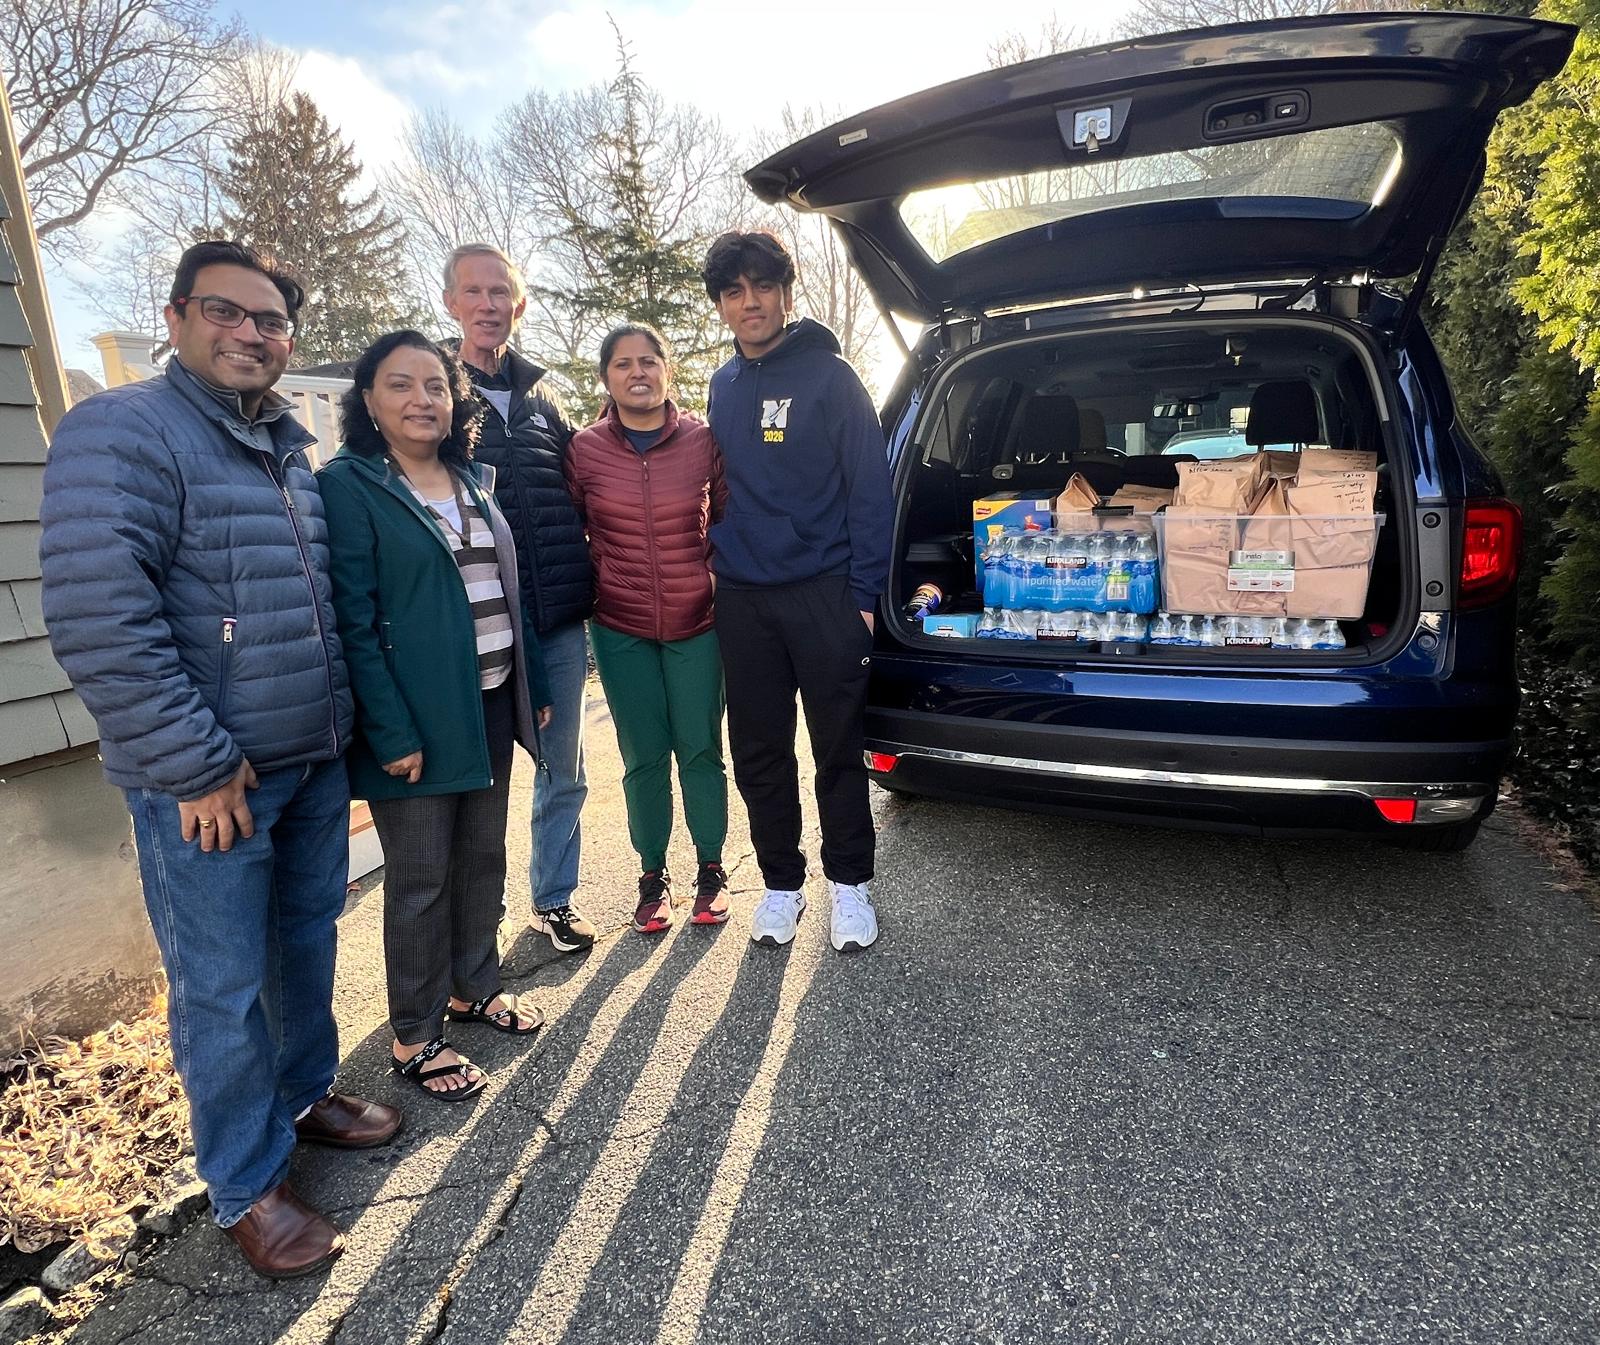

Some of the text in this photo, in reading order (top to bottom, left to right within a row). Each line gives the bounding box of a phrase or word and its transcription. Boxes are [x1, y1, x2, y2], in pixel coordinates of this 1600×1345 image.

[763, 430, 784, 443] 2026
[1046, 557, 1086, 565] KIRKLAND
[1030, 575, 1070, 587] purified
[1037, 630, 1077, 638] KIRKLAND
[1226, 637, 1271, 645] KIRKLAND
